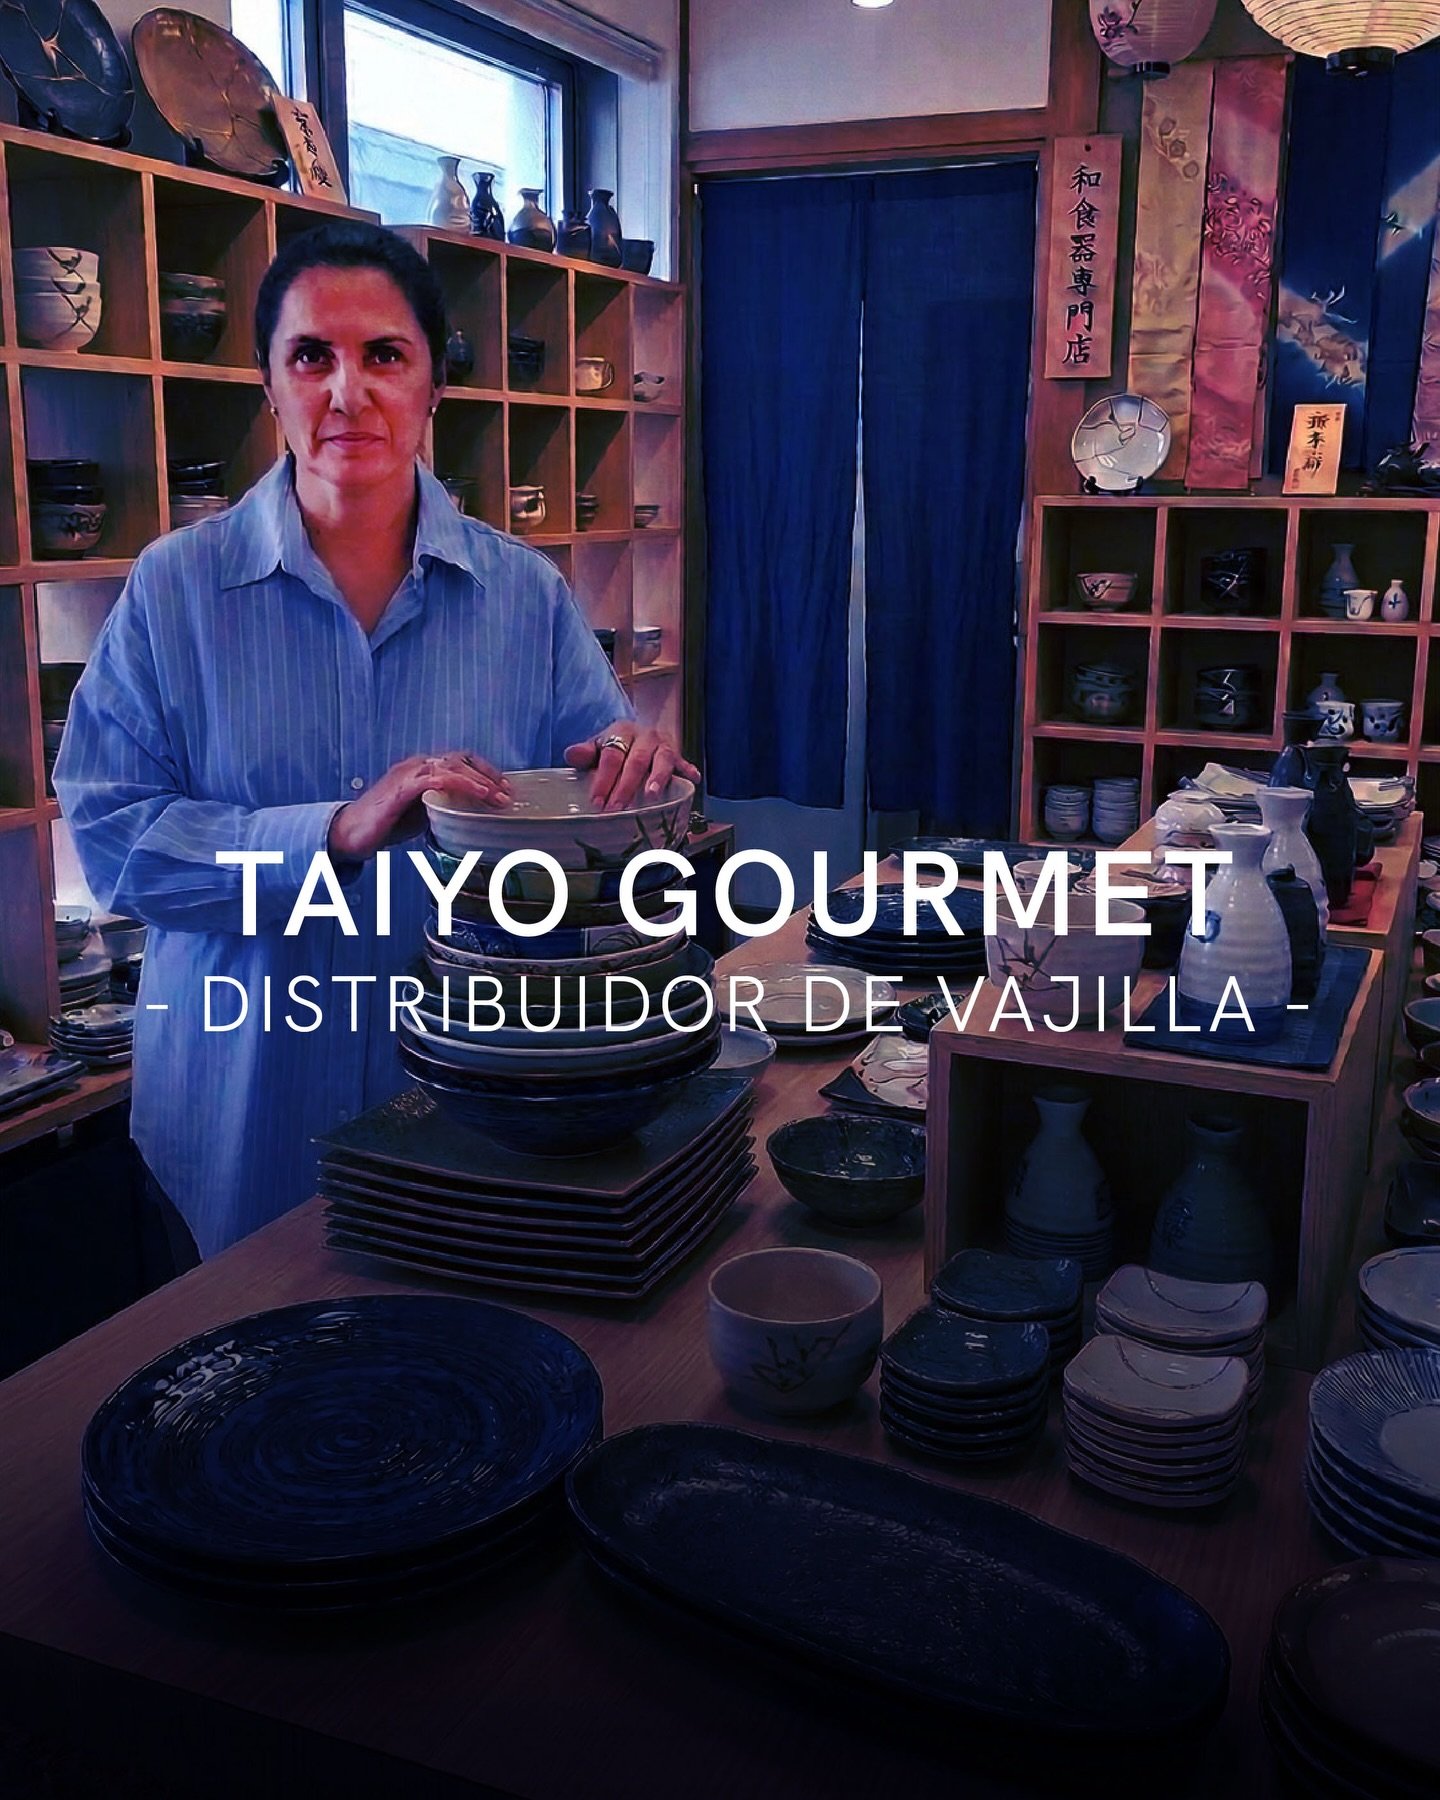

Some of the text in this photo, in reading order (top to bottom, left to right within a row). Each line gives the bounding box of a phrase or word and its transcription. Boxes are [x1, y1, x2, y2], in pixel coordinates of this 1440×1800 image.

[1062, 164, 1102, 366] 和食器専門店
